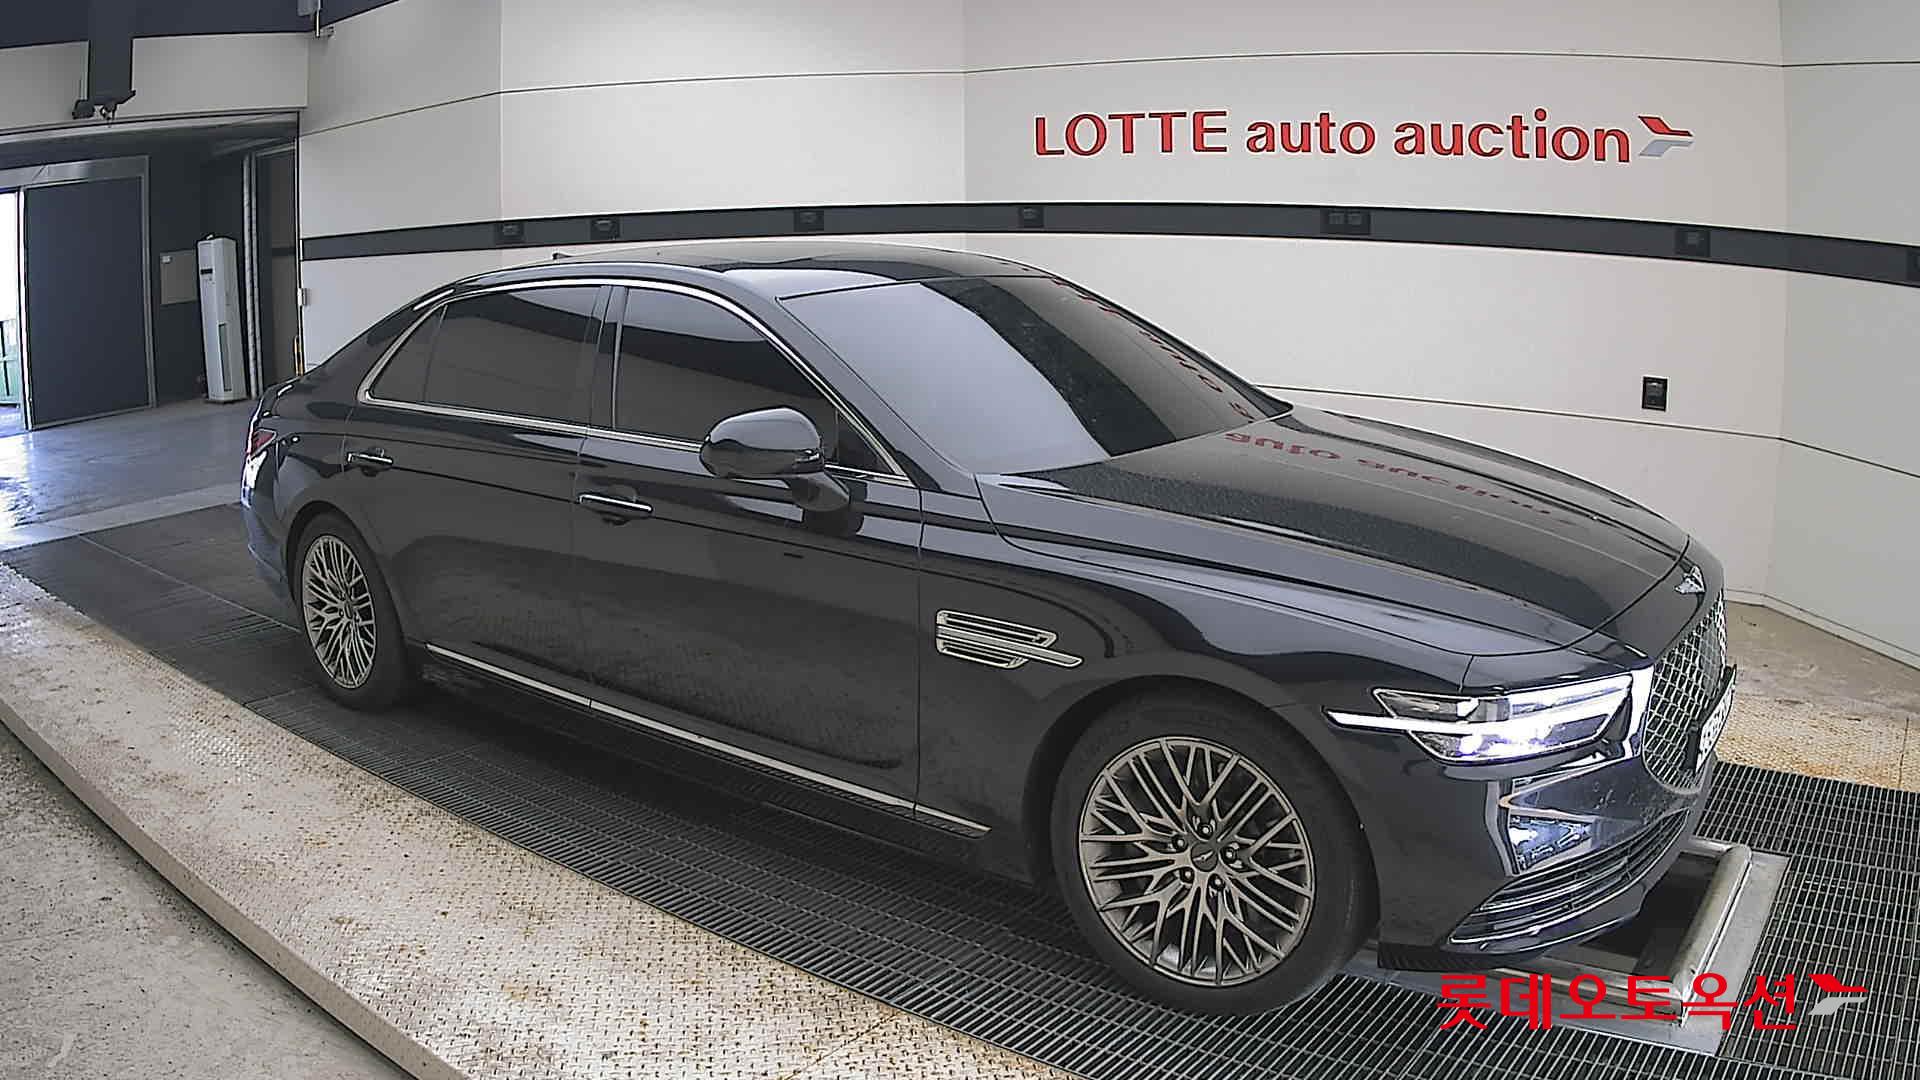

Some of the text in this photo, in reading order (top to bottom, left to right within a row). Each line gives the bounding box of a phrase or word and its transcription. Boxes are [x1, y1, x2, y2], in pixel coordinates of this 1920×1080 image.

[1034, 108, 1631, 163] LOTTE auto auction
